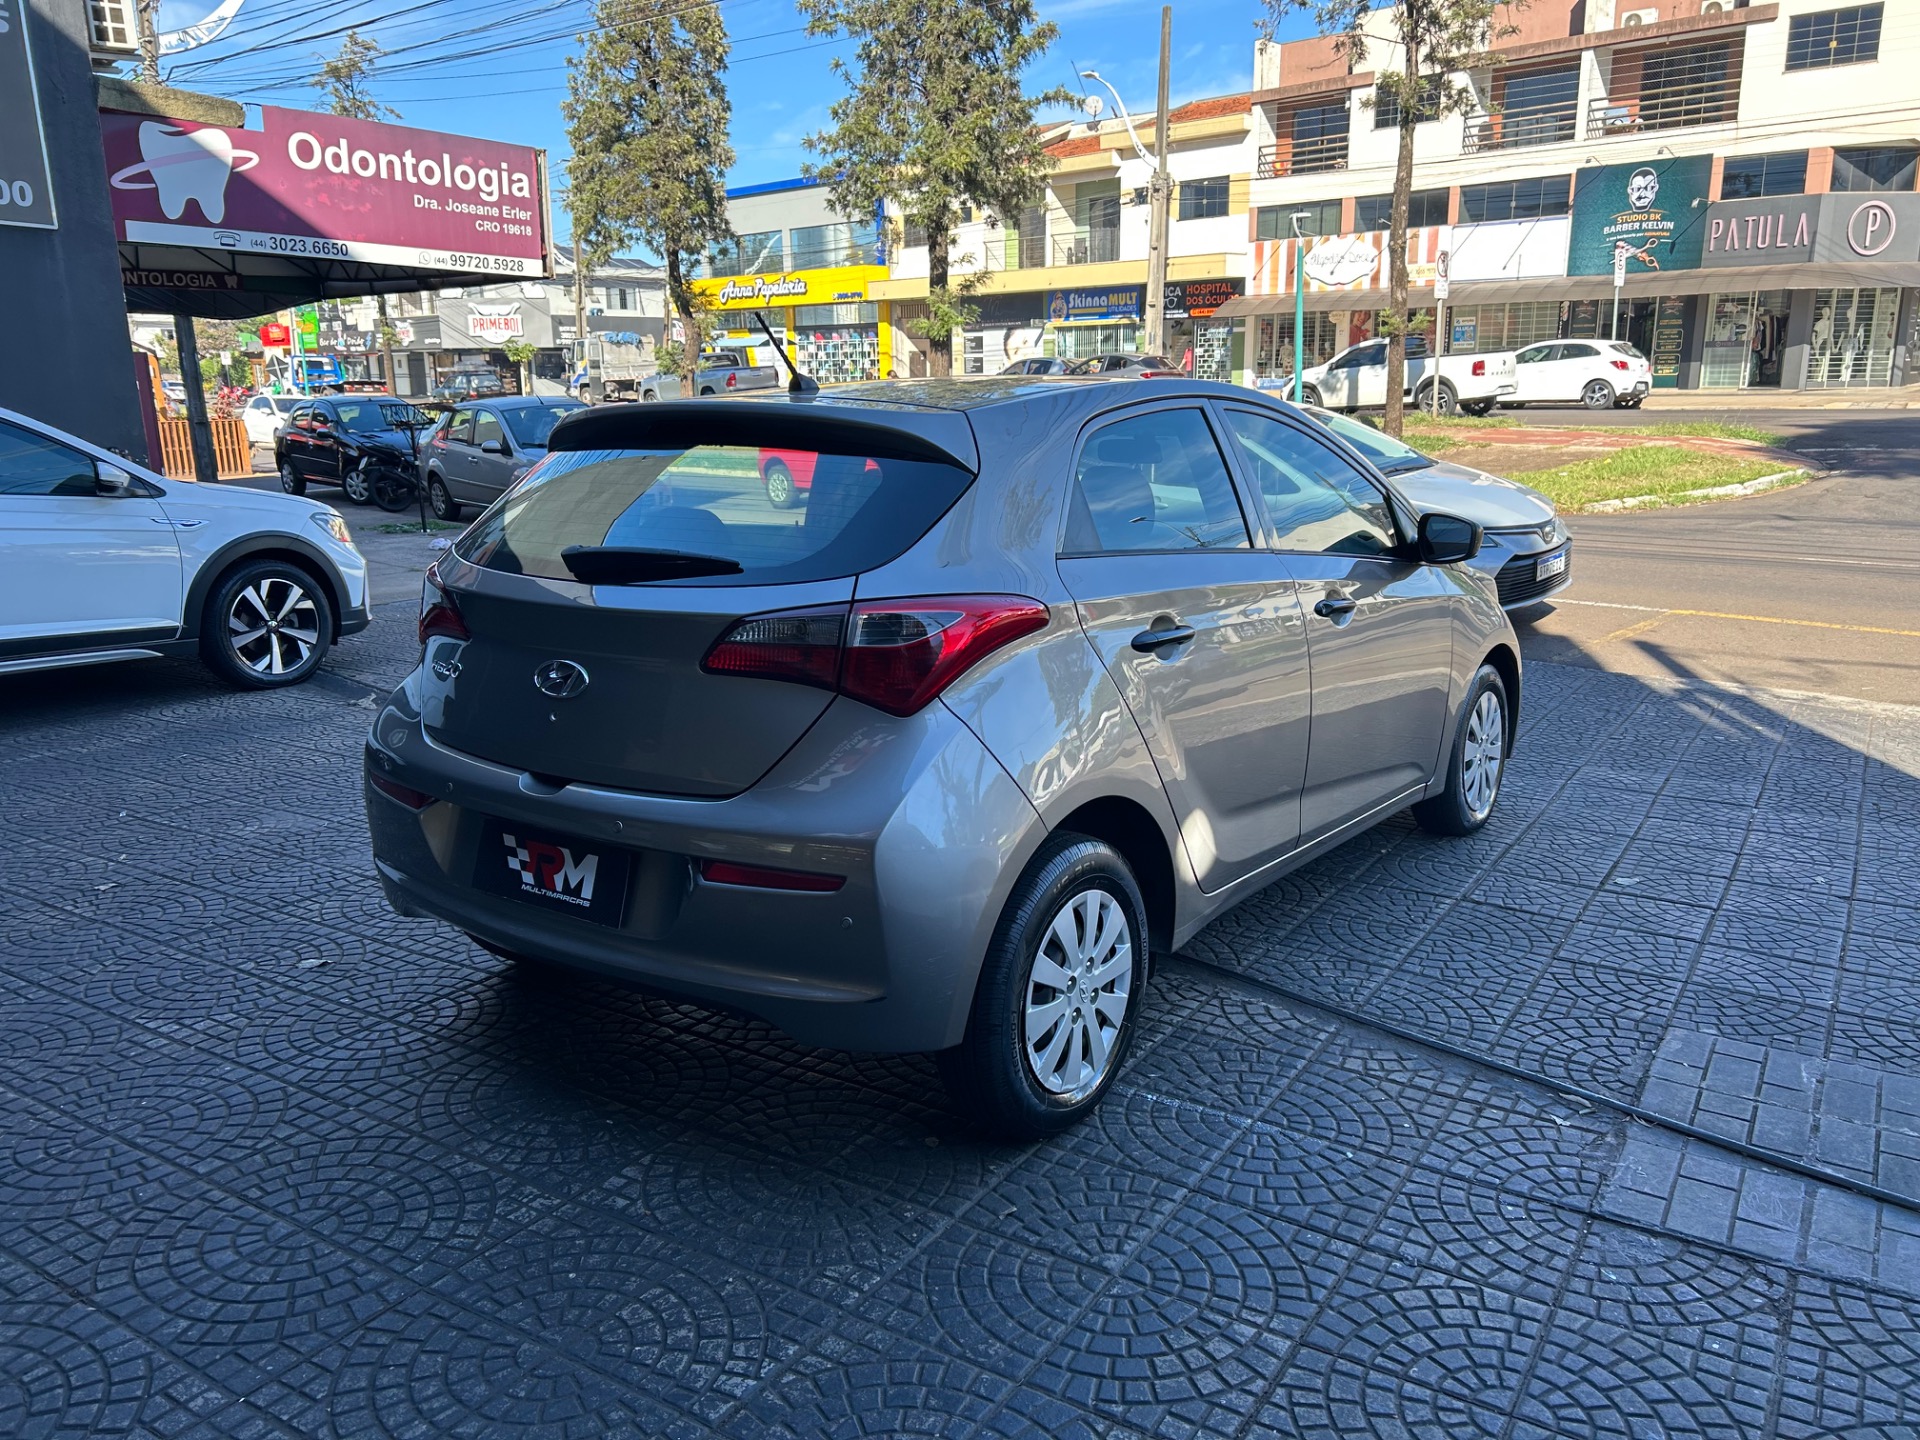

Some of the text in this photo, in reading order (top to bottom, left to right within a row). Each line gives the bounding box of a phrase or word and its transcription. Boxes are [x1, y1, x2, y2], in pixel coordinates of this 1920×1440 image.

[287, 131, 531, 202] Odontologia
[413, 194, 532, 221] Dra. Joseane Erler
[475, 220, 532, 236] CRO 19618
[1603, 221, 1674, 234] BARBER KELVIN
[1617, 213, 1661, 223] STUDIO BK
[1709, 212, 1809, 252] PATULA
[250, 236, 349, 257] (44) 3023.6650
[434, 253, 524, 273] (44) 99720.5928
[719, 276, 807, 304] Anna Papelaria
[1186, 282, 1233, 294] HOSPITAL
[1186, 296, 1203, 305] DOS
[472, 317, 519, 334] PRIMEBOI
[521, 884, 591, 907] MULTIMARCAS
